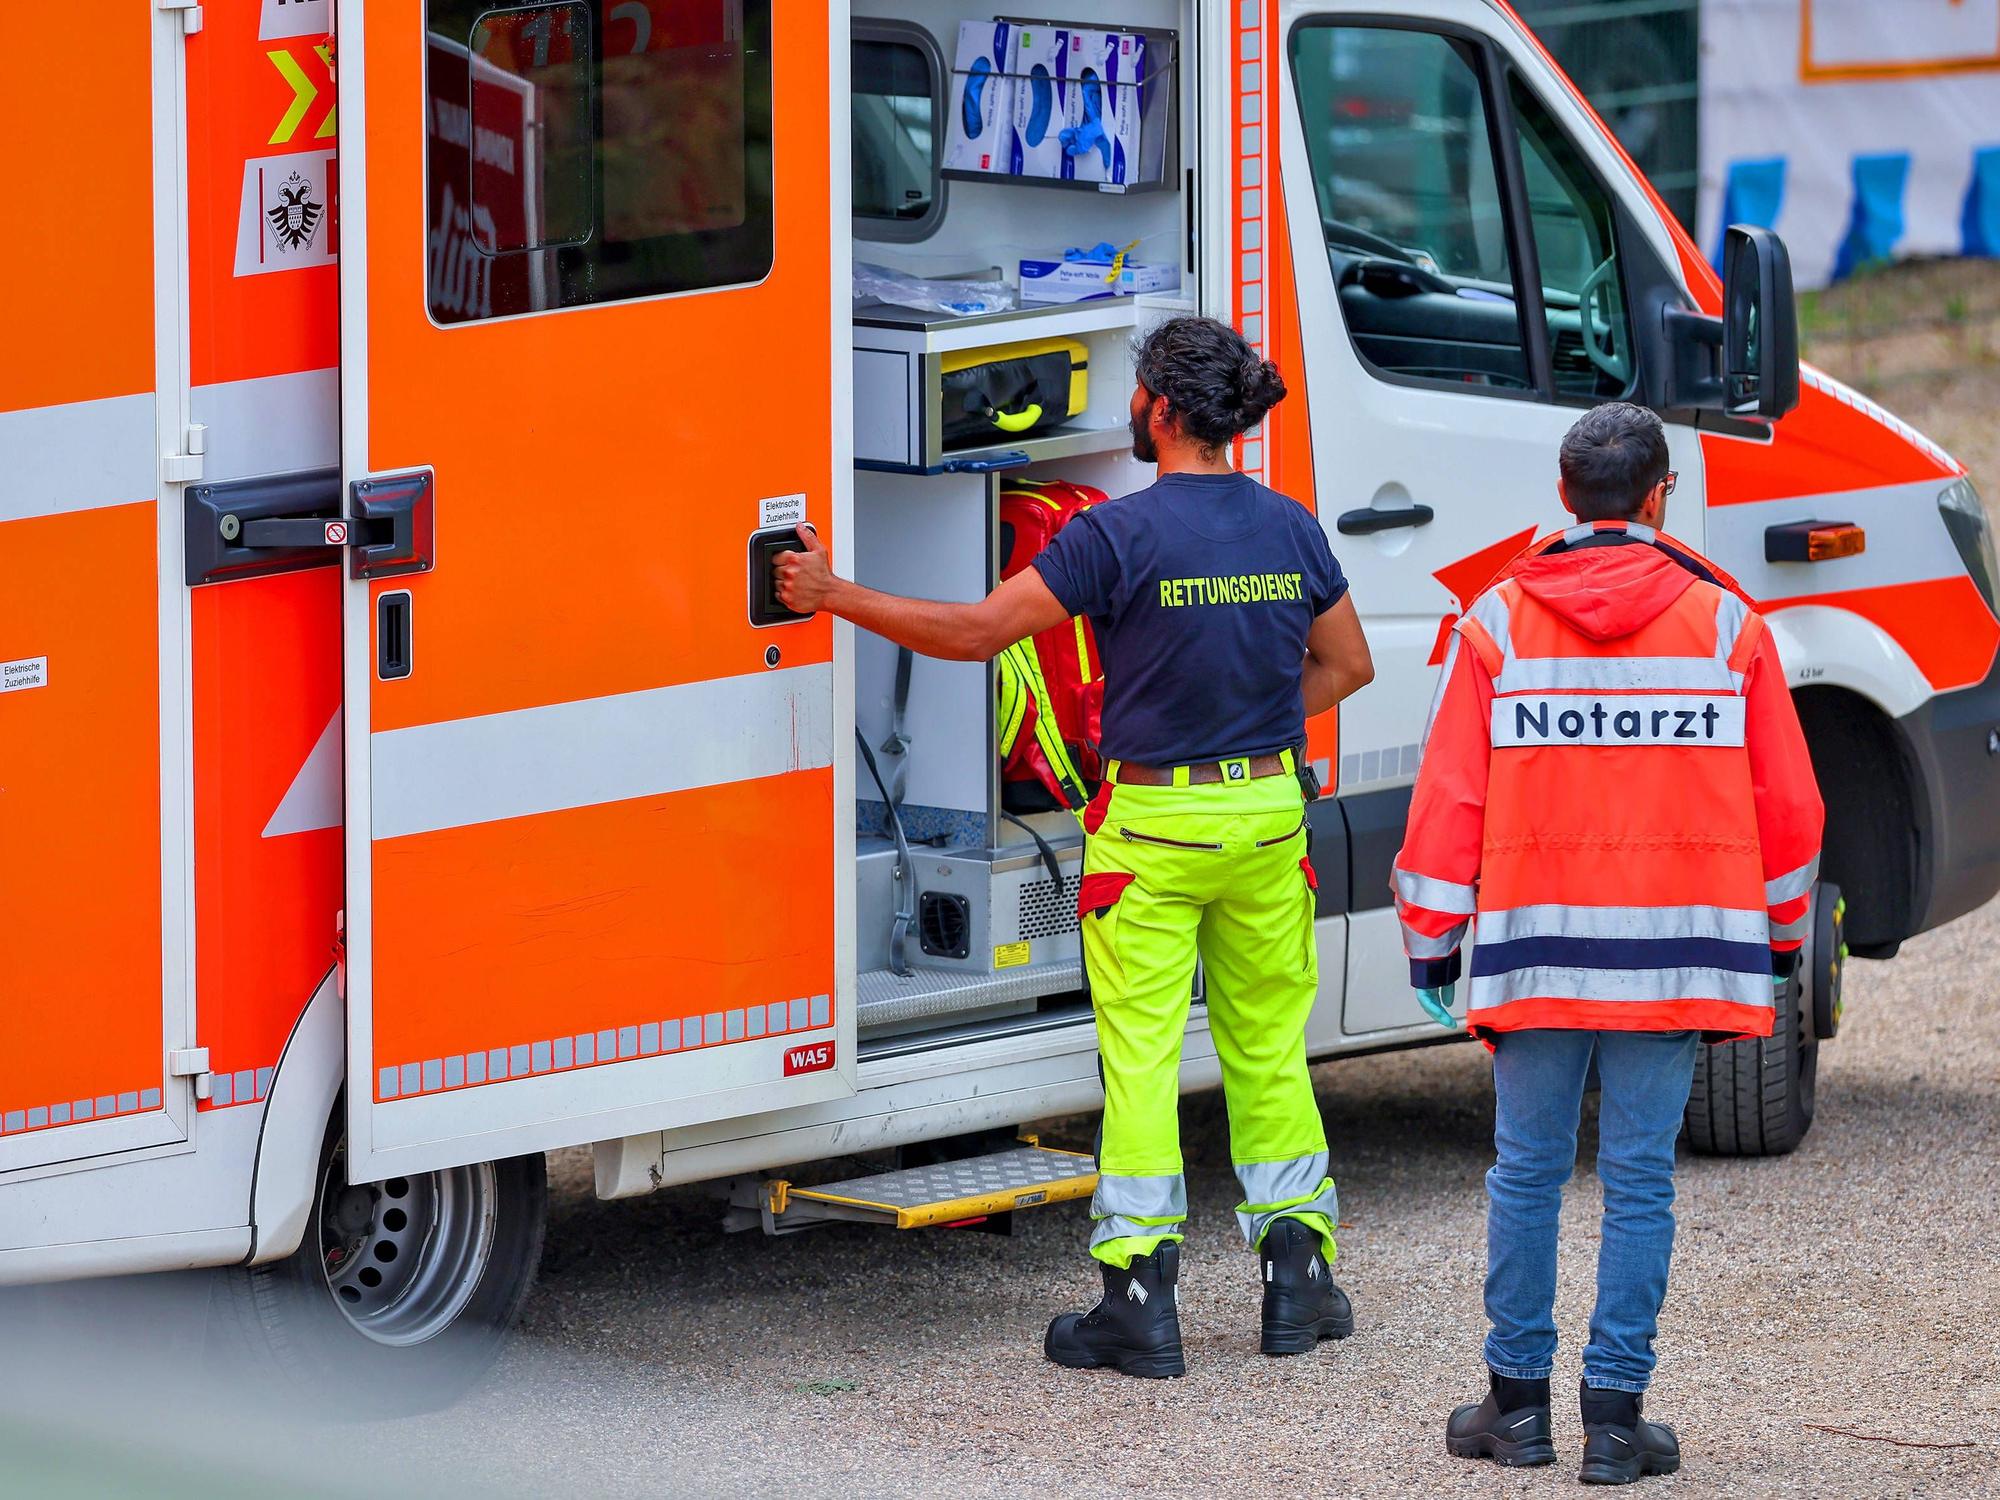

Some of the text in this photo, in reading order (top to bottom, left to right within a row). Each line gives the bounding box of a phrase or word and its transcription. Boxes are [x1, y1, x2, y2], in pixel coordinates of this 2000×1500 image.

[766, 499, 800, 511] Elektrische
[766, 511, 800, 523] Zuziehhilfe
[1159, 573, 1303, 607] RETTUNGSDIENST
[4, 663, 40, 675] Elektrische
[4, 675, 40, 688] Zuziehhilfe
[1515, 701, 1720, 739] Notarzt
[790, 1047, 828, 1069] WAS
